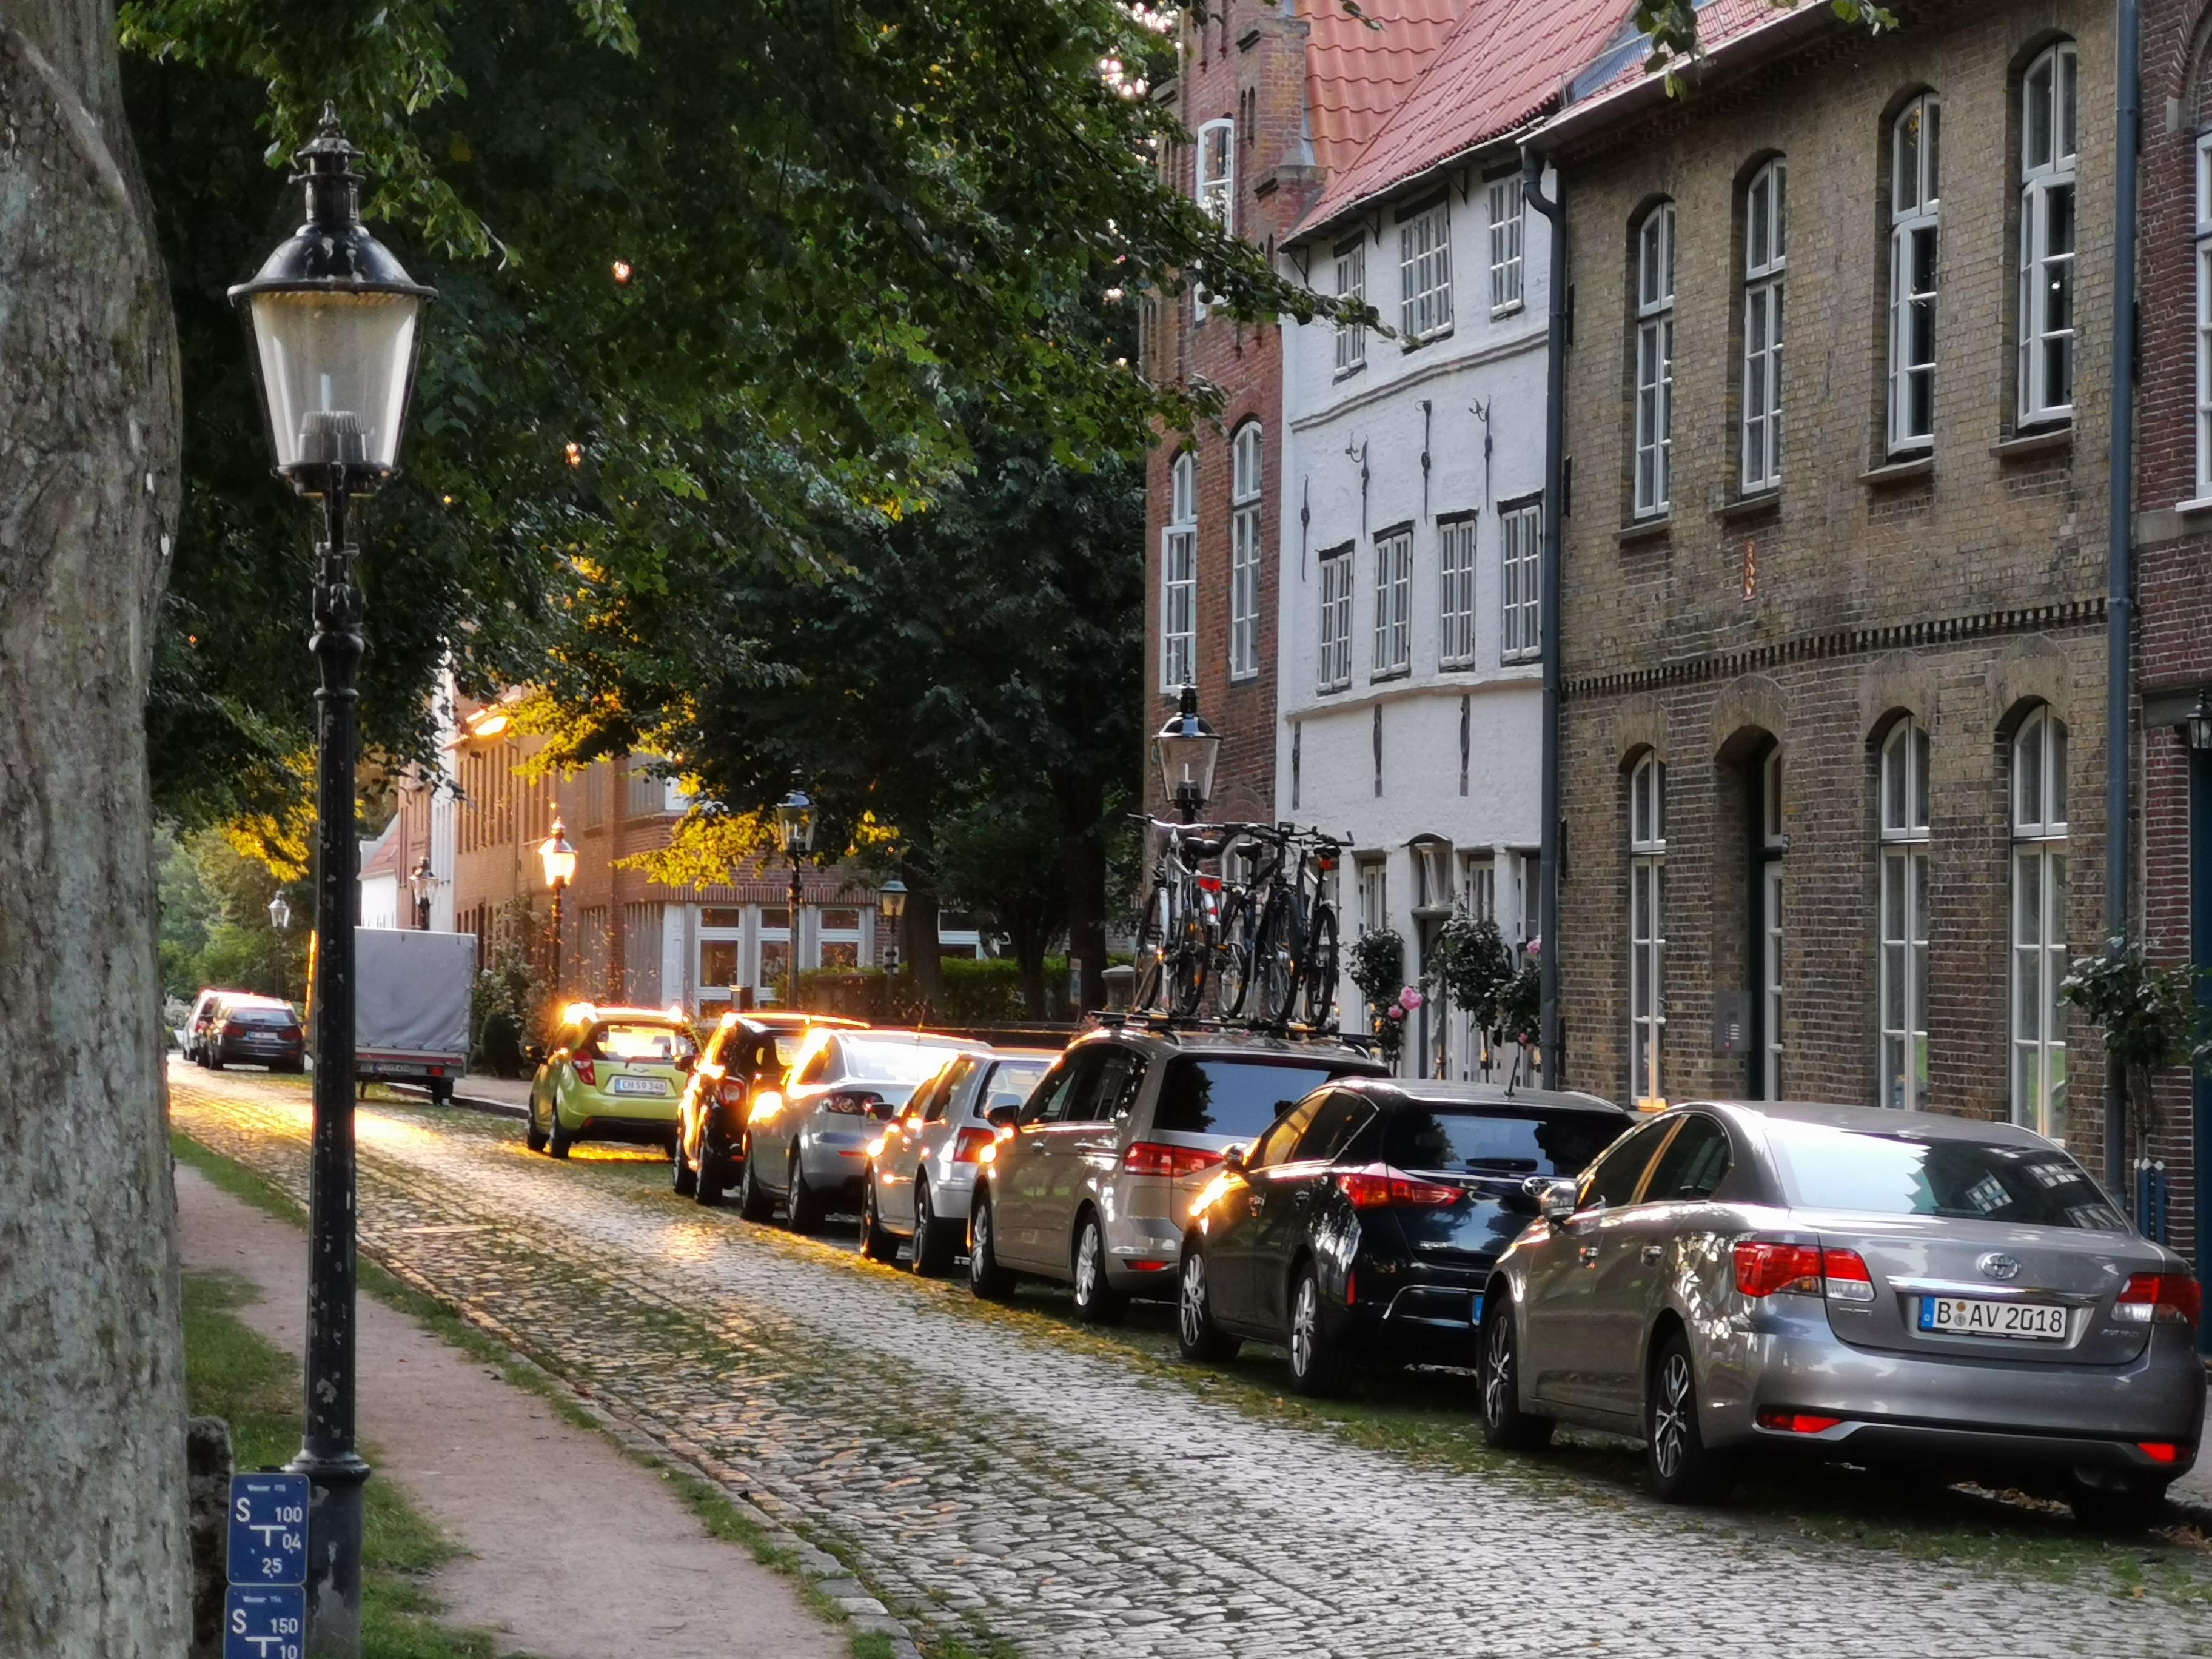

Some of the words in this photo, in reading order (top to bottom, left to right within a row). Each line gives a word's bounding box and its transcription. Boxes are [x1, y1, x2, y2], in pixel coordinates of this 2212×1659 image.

[1937, 1301, 1951, 1324] B
[1969, 1304, 2000, 1328] AV
[2005, 1307, 2062, 1333] 2018
[236, 1497, 251, 1523] S
[275, 1506, 303, 1523] 100
[282, 1533, 302, 1550] 04
[262, 1558, 283, 1574] 25
[232, 1609, 247, 1634] S
[271, 1618, 298, 1634] 150
[279, 1644, 298, 1659] 10
